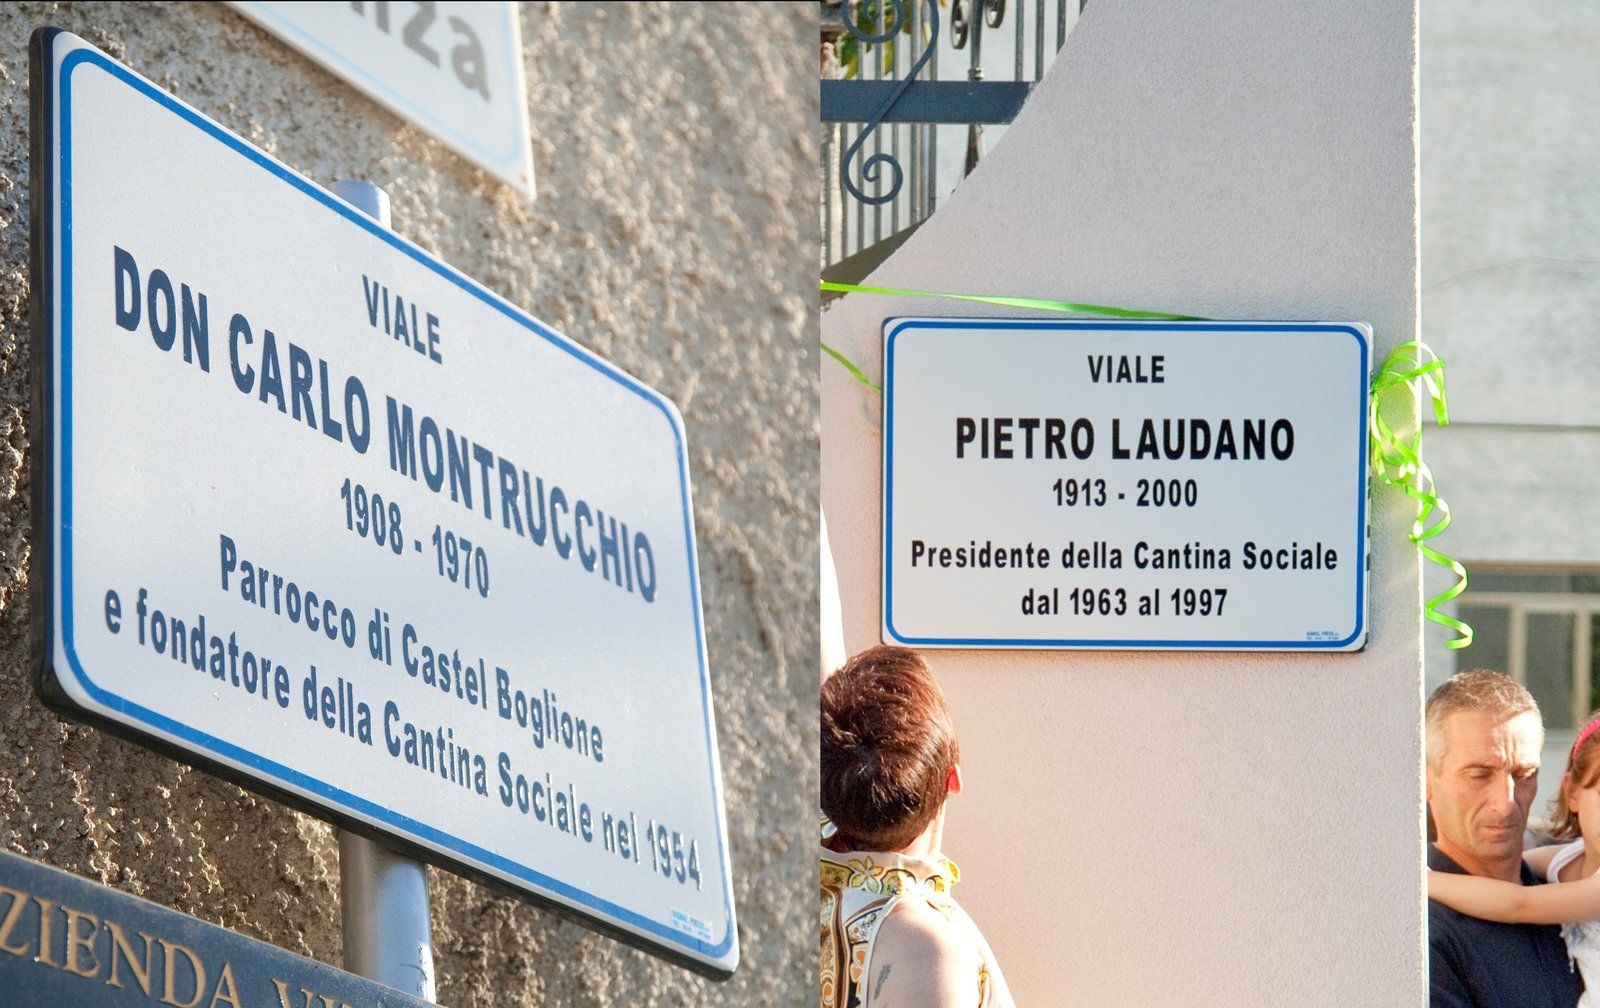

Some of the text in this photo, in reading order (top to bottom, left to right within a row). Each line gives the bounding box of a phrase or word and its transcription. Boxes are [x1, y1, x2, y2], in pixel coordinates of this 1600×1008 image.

[362, 274, 443, 365] VIALE
[1087, 355, 1165, 384] VIALE
[113, 245, 657, 604] DON CARLO MONTRUCCHIO
[956, 417, 1295, 462] PIETRO LAUDANO
[340, 477, 490, 599] 1908 - 1970
[1052, 478, 1107, 507] 1913
[1136, 478, 1198, 508] 2000
[911, 540, 1338, 571] Presidente della Cantina Sociale
[1021, 587, 1228, 617] dal 1963 al 1997
[219, 533, 604, 763] Parrocco di Castel Boglione
[104, 587, 701, 891] e fondatore della Cantina Sociale nel 1954
[0, 886, 242, 1008] ZIENDA
